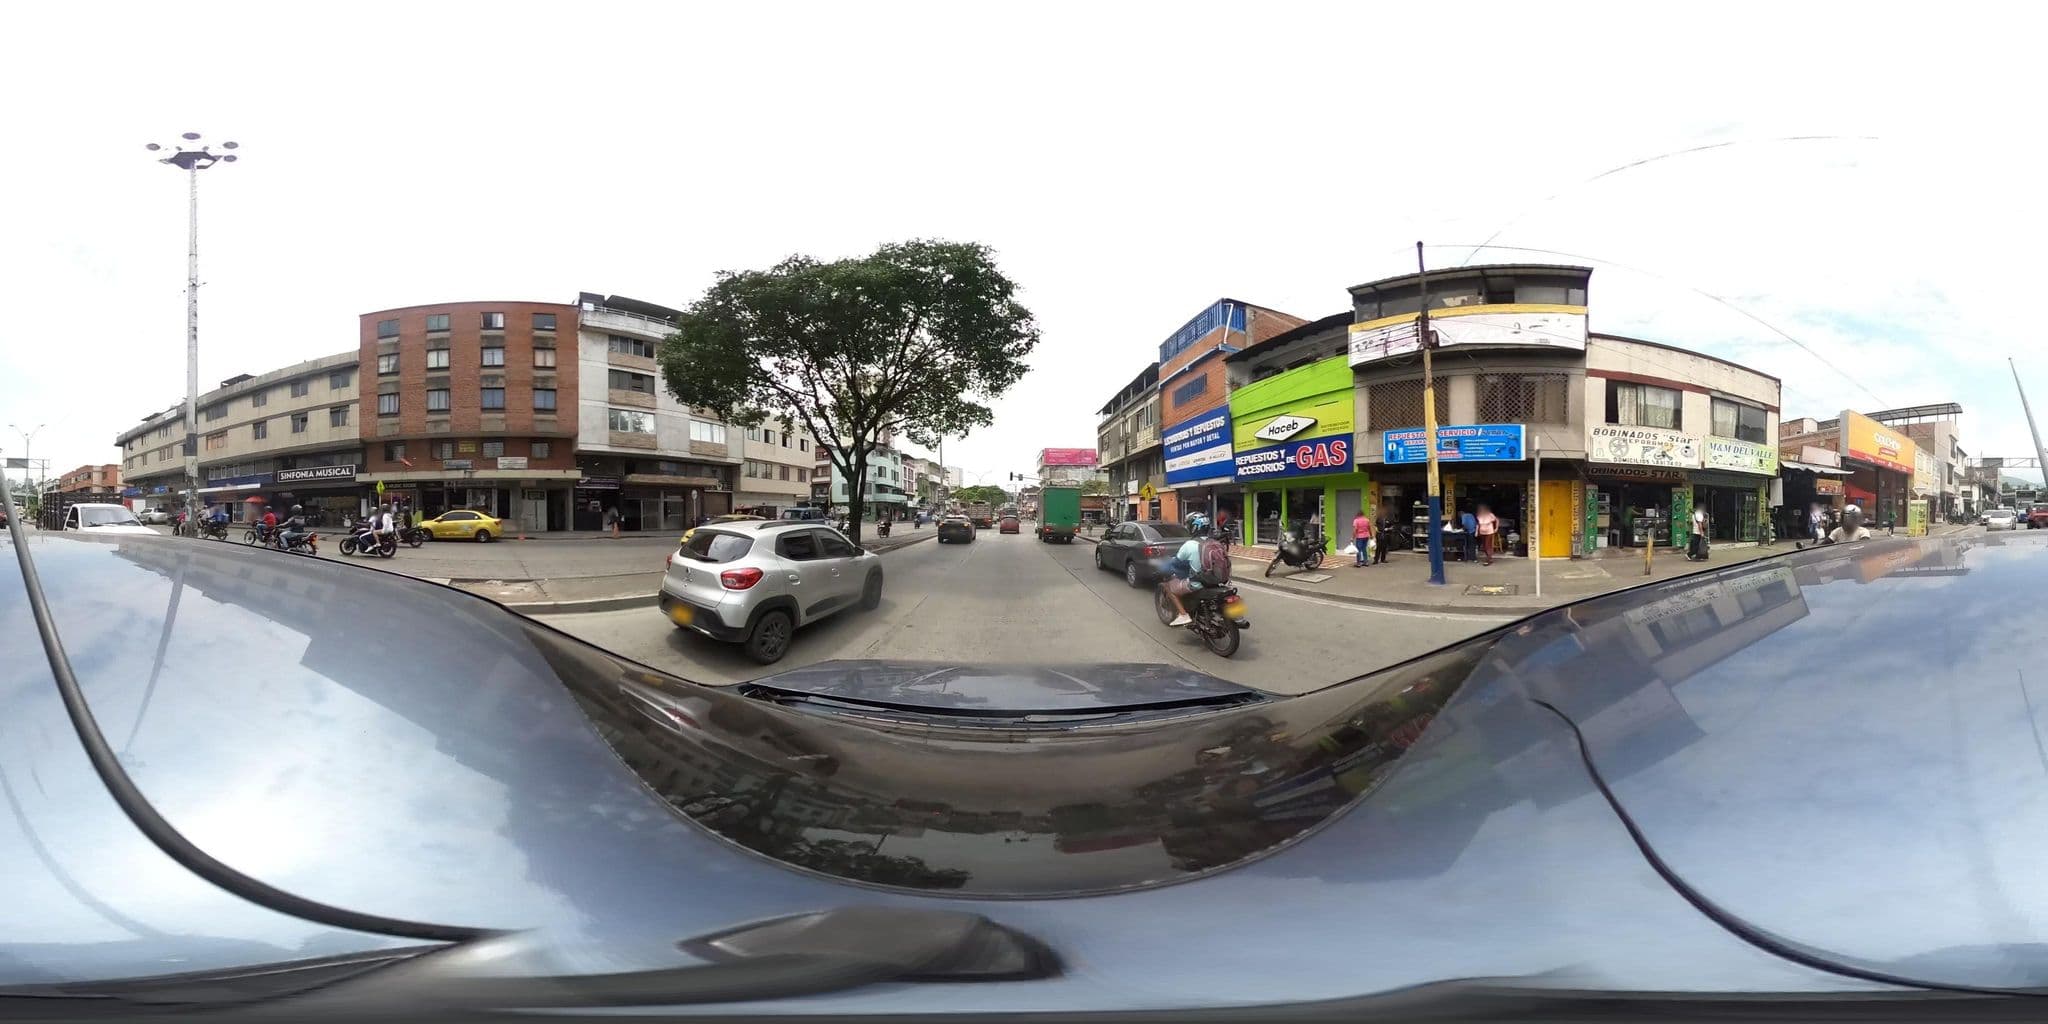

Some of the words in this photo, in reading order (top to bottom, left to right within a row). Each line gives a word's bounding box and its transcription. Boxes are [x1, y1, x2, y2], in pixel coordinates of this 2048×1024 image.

[1194, 416, 1225, 435] REPUESTOS
[1268, 419, 1299, 436] Haceb
[1592, 428, 1659, 440] BOBINADOS
[1388, 432, 1428, 441] REPUESTO
[1439, 428, 1477, 437] SERVICIO
[1235, 451, 1279, 466] REPUESTOS
[1279, 449, 1286, 459] Y
[1296, 440, 1348, 470] GAS
[1710, 442, 1733, 453] M&M
[1733, 446, 1750, 455] DEL
[1751, 448, 1775, 459] VALLE
[280, 470, 315, 480] SINFONIA
[315, 467, 351, 478] MUSICAL
[1237, 461, 1286, 476] ACCESORIOS
